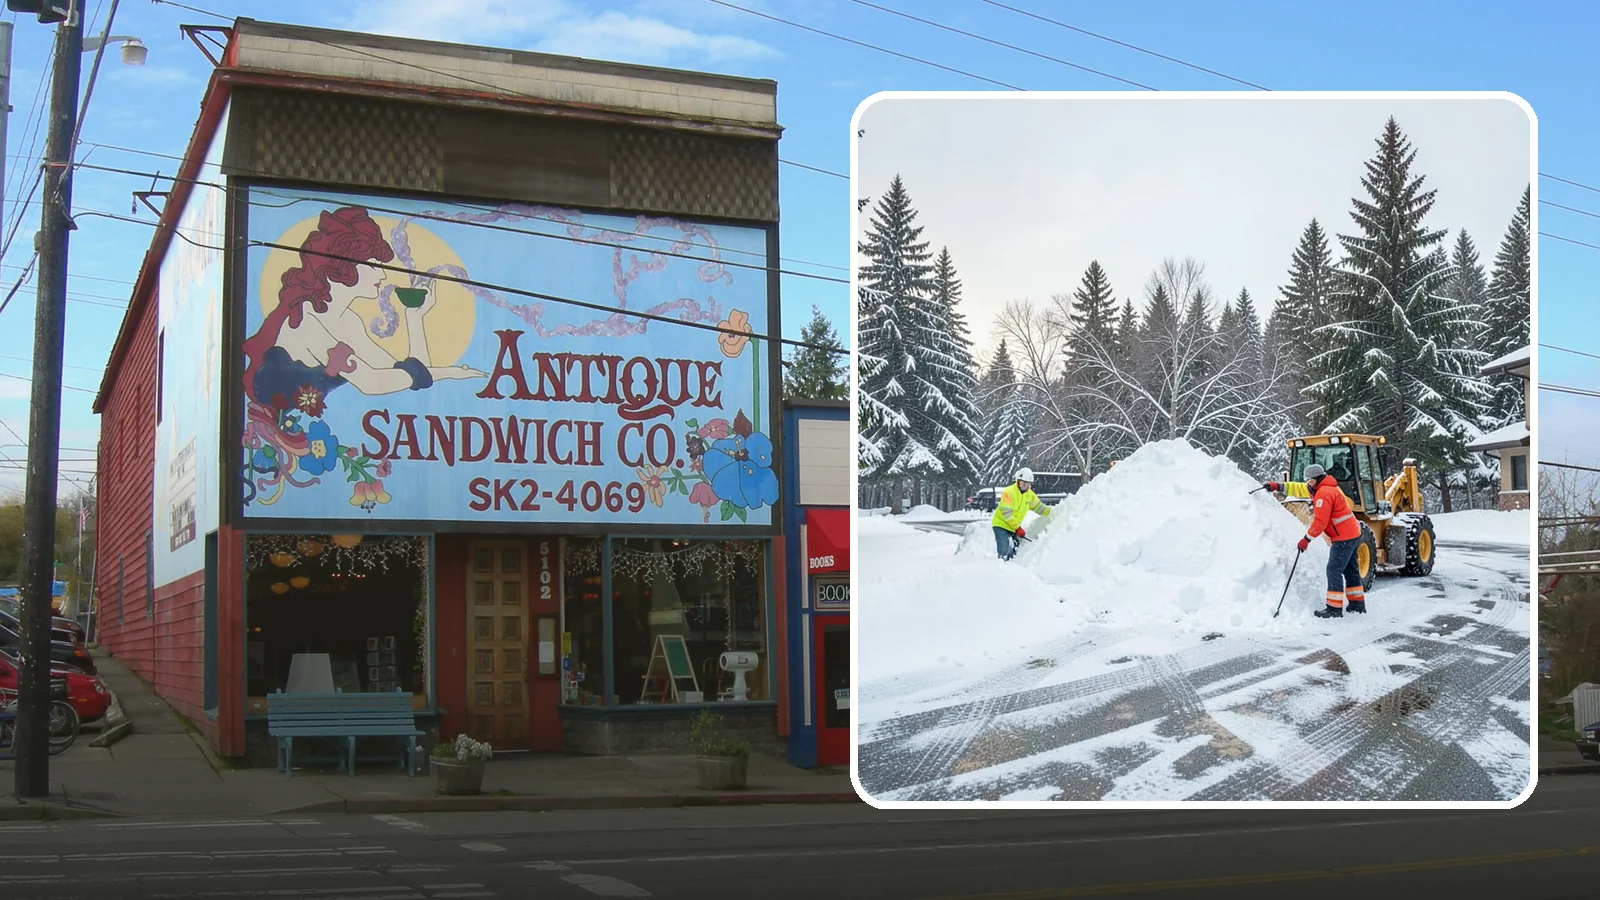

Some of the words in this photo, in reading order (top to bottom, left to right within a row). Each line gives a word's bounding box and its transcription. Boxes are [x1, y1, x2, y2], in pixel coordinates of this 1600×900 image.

[475, 329, 724, 421] ANTIQUE
[361, 409, 604, 467] SANDWICH
[617, 422, 685, 468] CO.
[468, 477, 646, 513] SK2-4069
[540, 541, 551, 600] 5102
[810, 555, 834, 569] BOOKS
